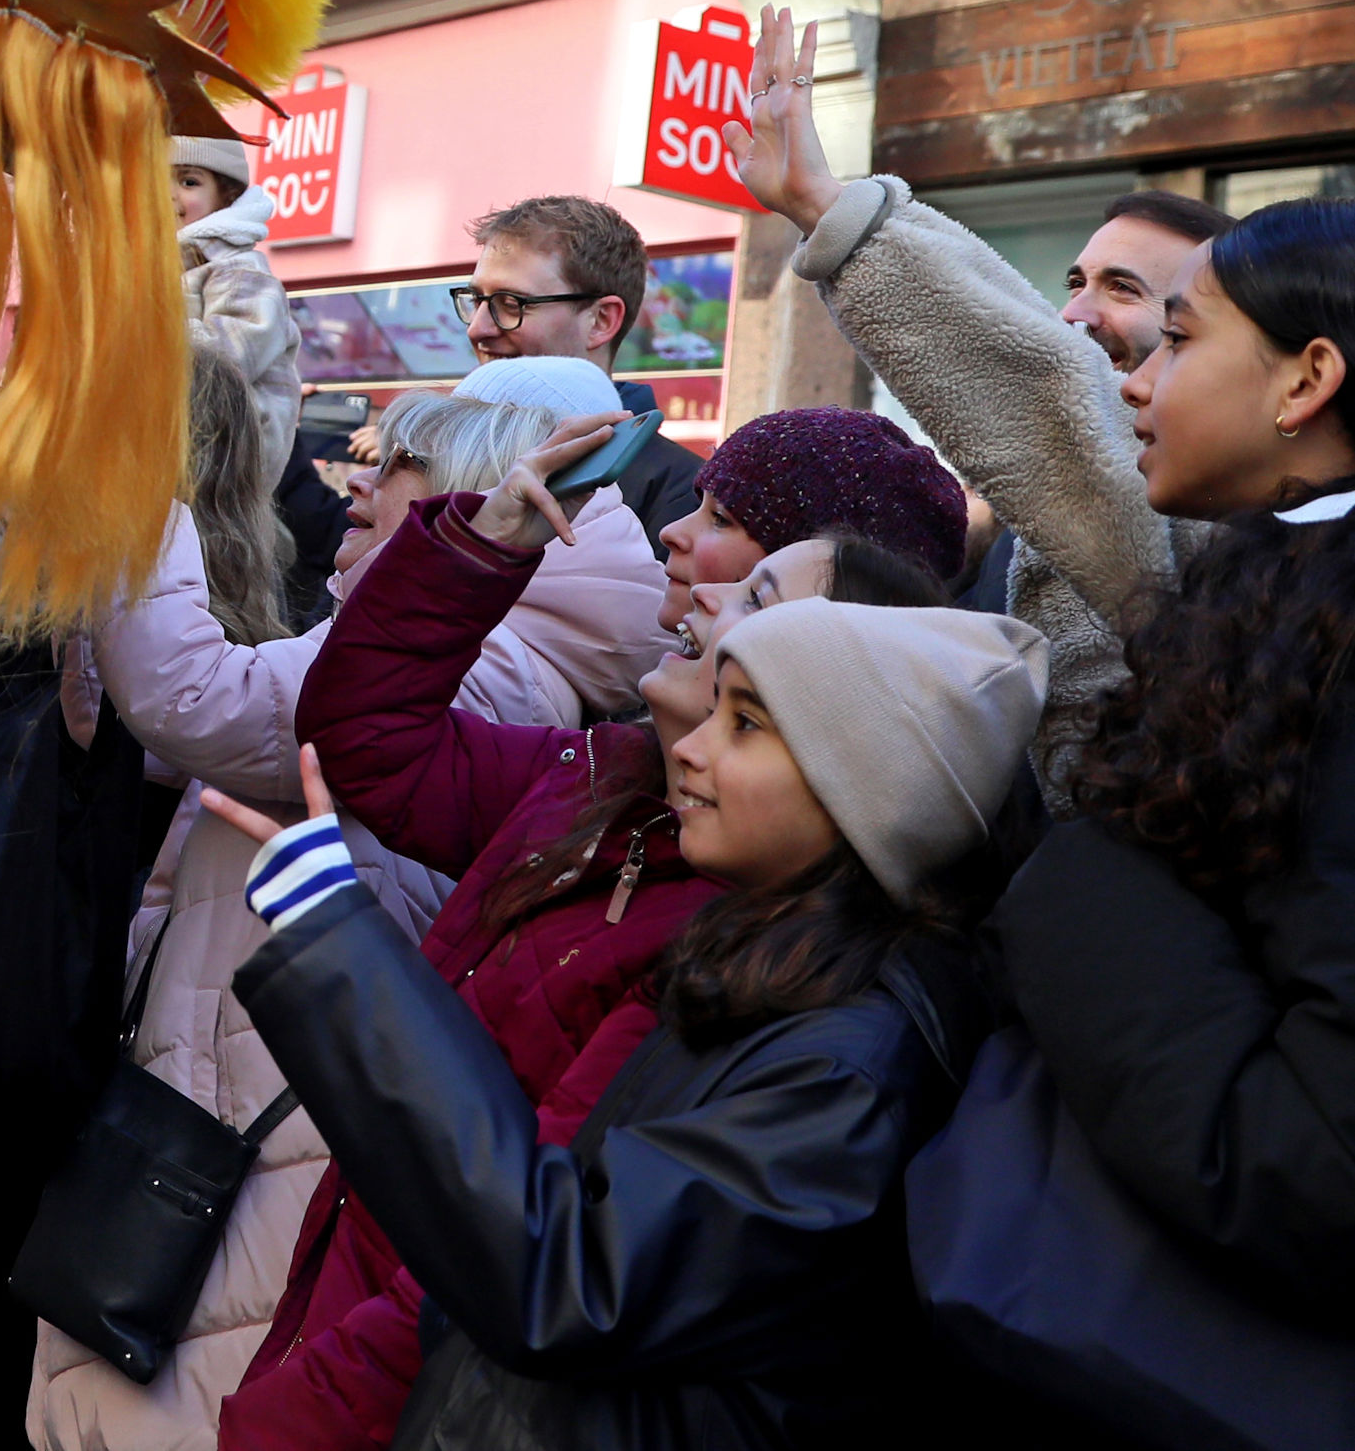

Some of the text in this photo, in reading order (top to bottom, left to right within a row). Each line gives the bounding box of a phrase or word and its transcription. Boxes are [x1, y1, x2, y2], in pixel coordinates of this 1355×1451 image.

[663, 50, 753, 120] MIN
[978, 19, 1193, 96] VIETEAT
[263, 108, 338, 164] MINI
